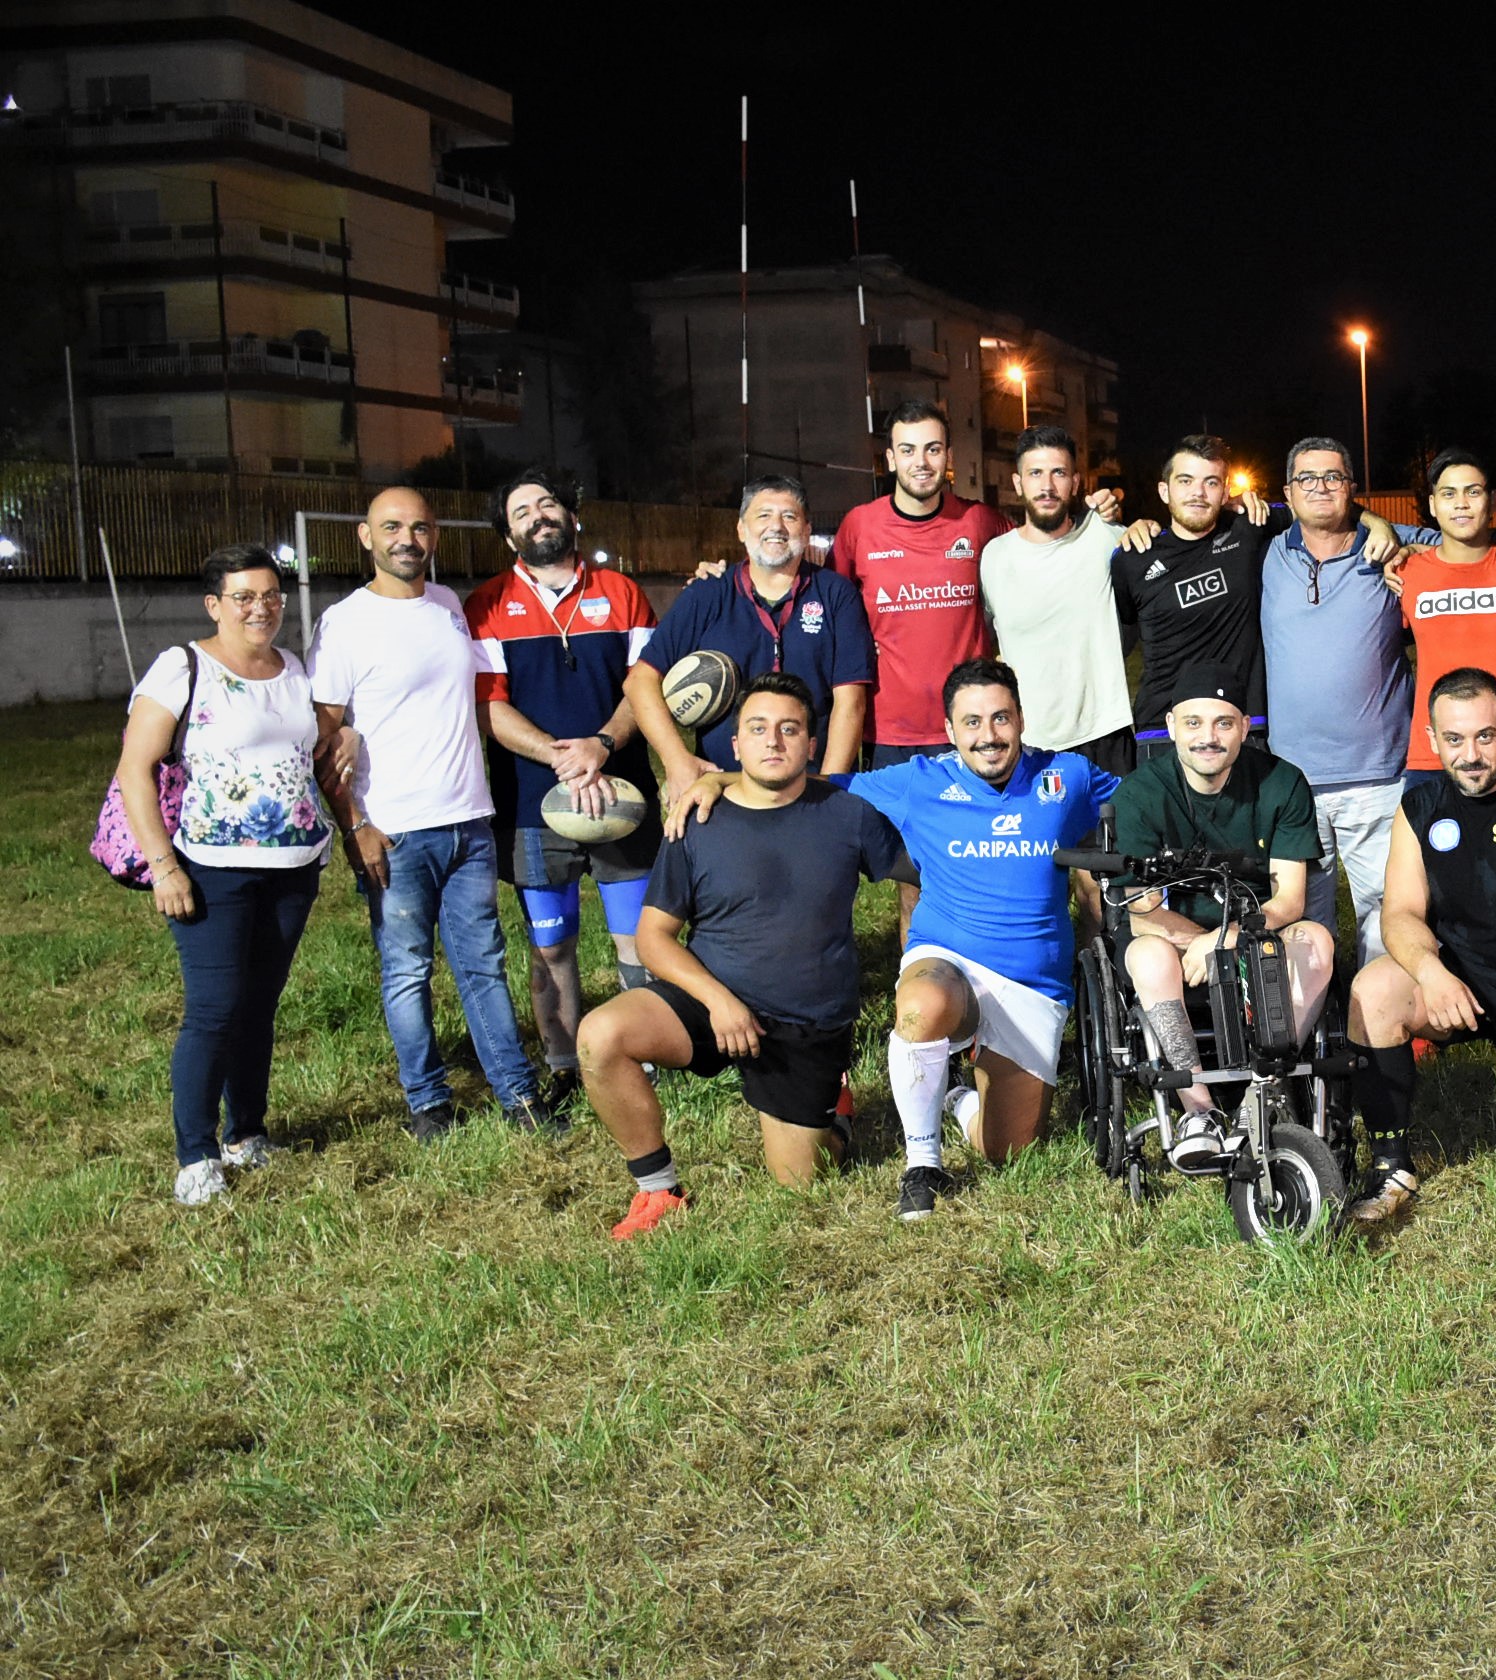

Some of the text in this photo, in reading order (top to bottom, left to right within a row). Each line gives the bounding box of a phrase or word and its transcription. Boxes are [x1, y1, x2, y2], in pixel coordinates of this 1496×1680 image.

[868, 550, 904, 560] macron
[896, 580, 975, 602] Aberdeen
[1186, 576, 1221, 602] AIG
[878, 605, 903, 614] GLOBAL
[904, 602, 927, 611] ASSET
[939, 793, 972, 802] adidas
